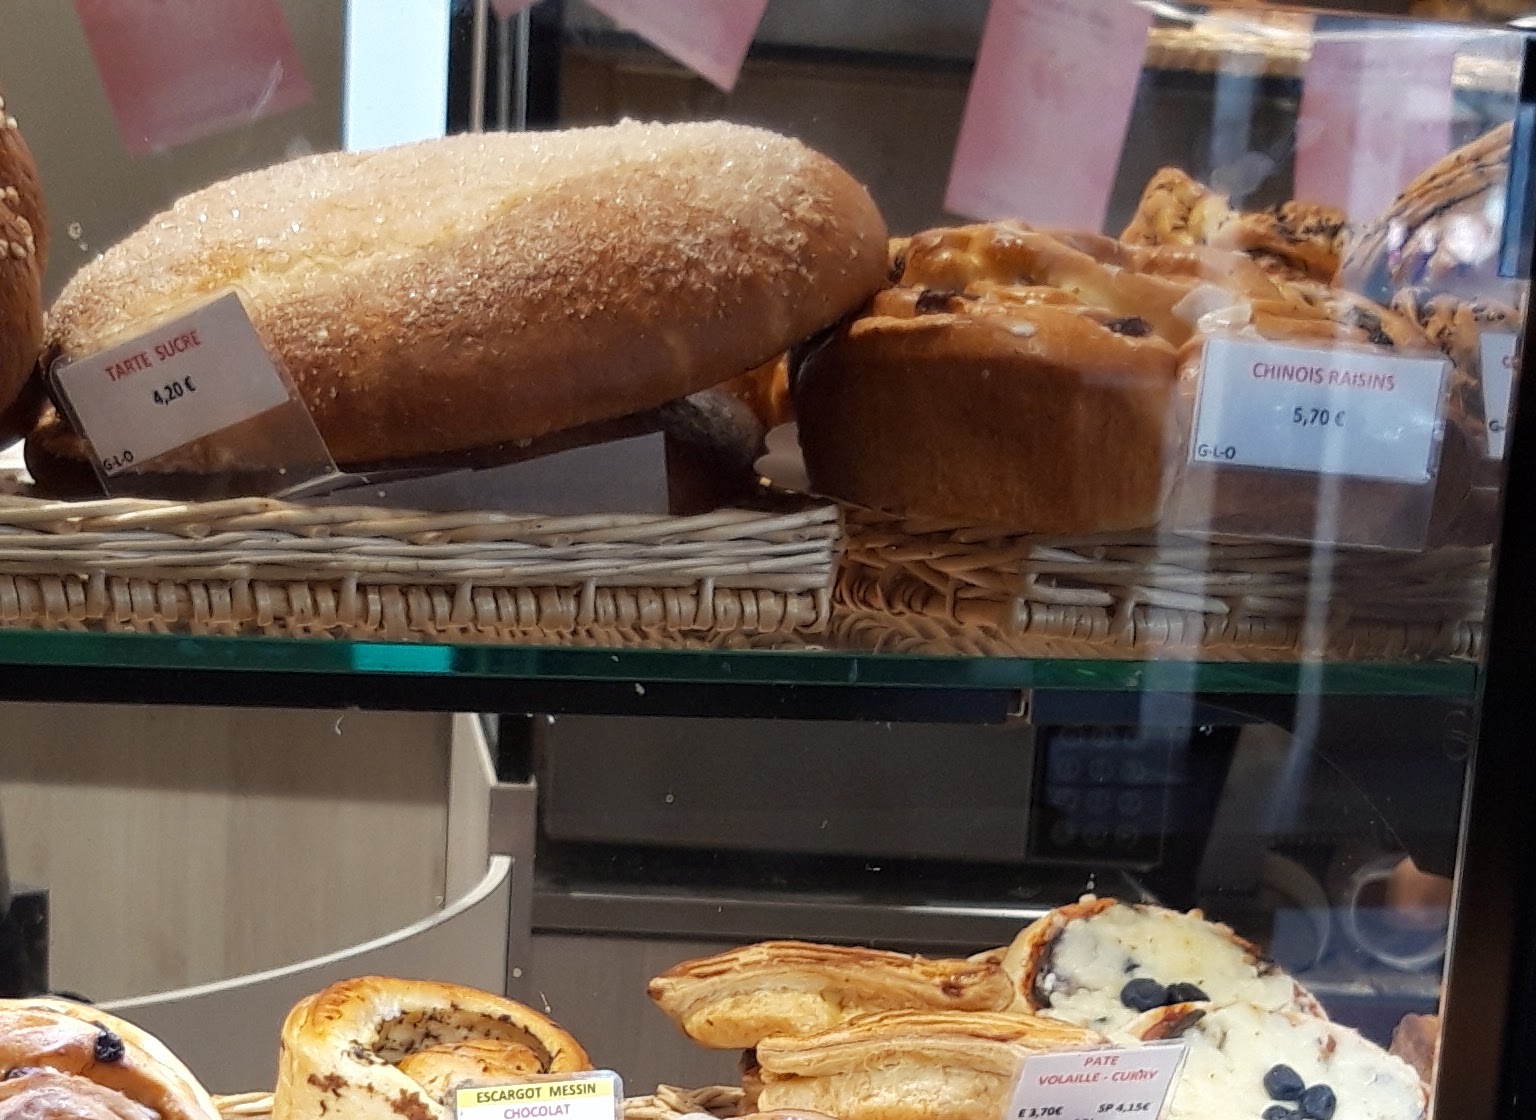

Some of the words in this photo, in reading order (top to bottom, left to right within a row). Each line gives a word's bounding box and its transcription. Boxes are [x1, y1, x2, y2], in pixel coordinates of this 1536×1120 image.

[105, 352, 152, 382] TARTE
[155, 329, 201, 361] SUCRE
[1252, 362, 1324, 383] CHINOIS
[1328, 372, 1396, 392] RAISINS
[1198, 444, 1236, 460] G-L-O
[1083, 1055, 1119, 1067] PATE
[1039, 1072, 1100, 1086] VOLAILLE
[1111, 1069, 1159, 1082] CURRY
[477, 1087, 542, 1103] ESCARGOT
[550, 1083, 596, 1097] MESSIN
[504, 1104, 571, 1120] CHOCOLAT
[1097, 1103, 1114, 1113] SP
